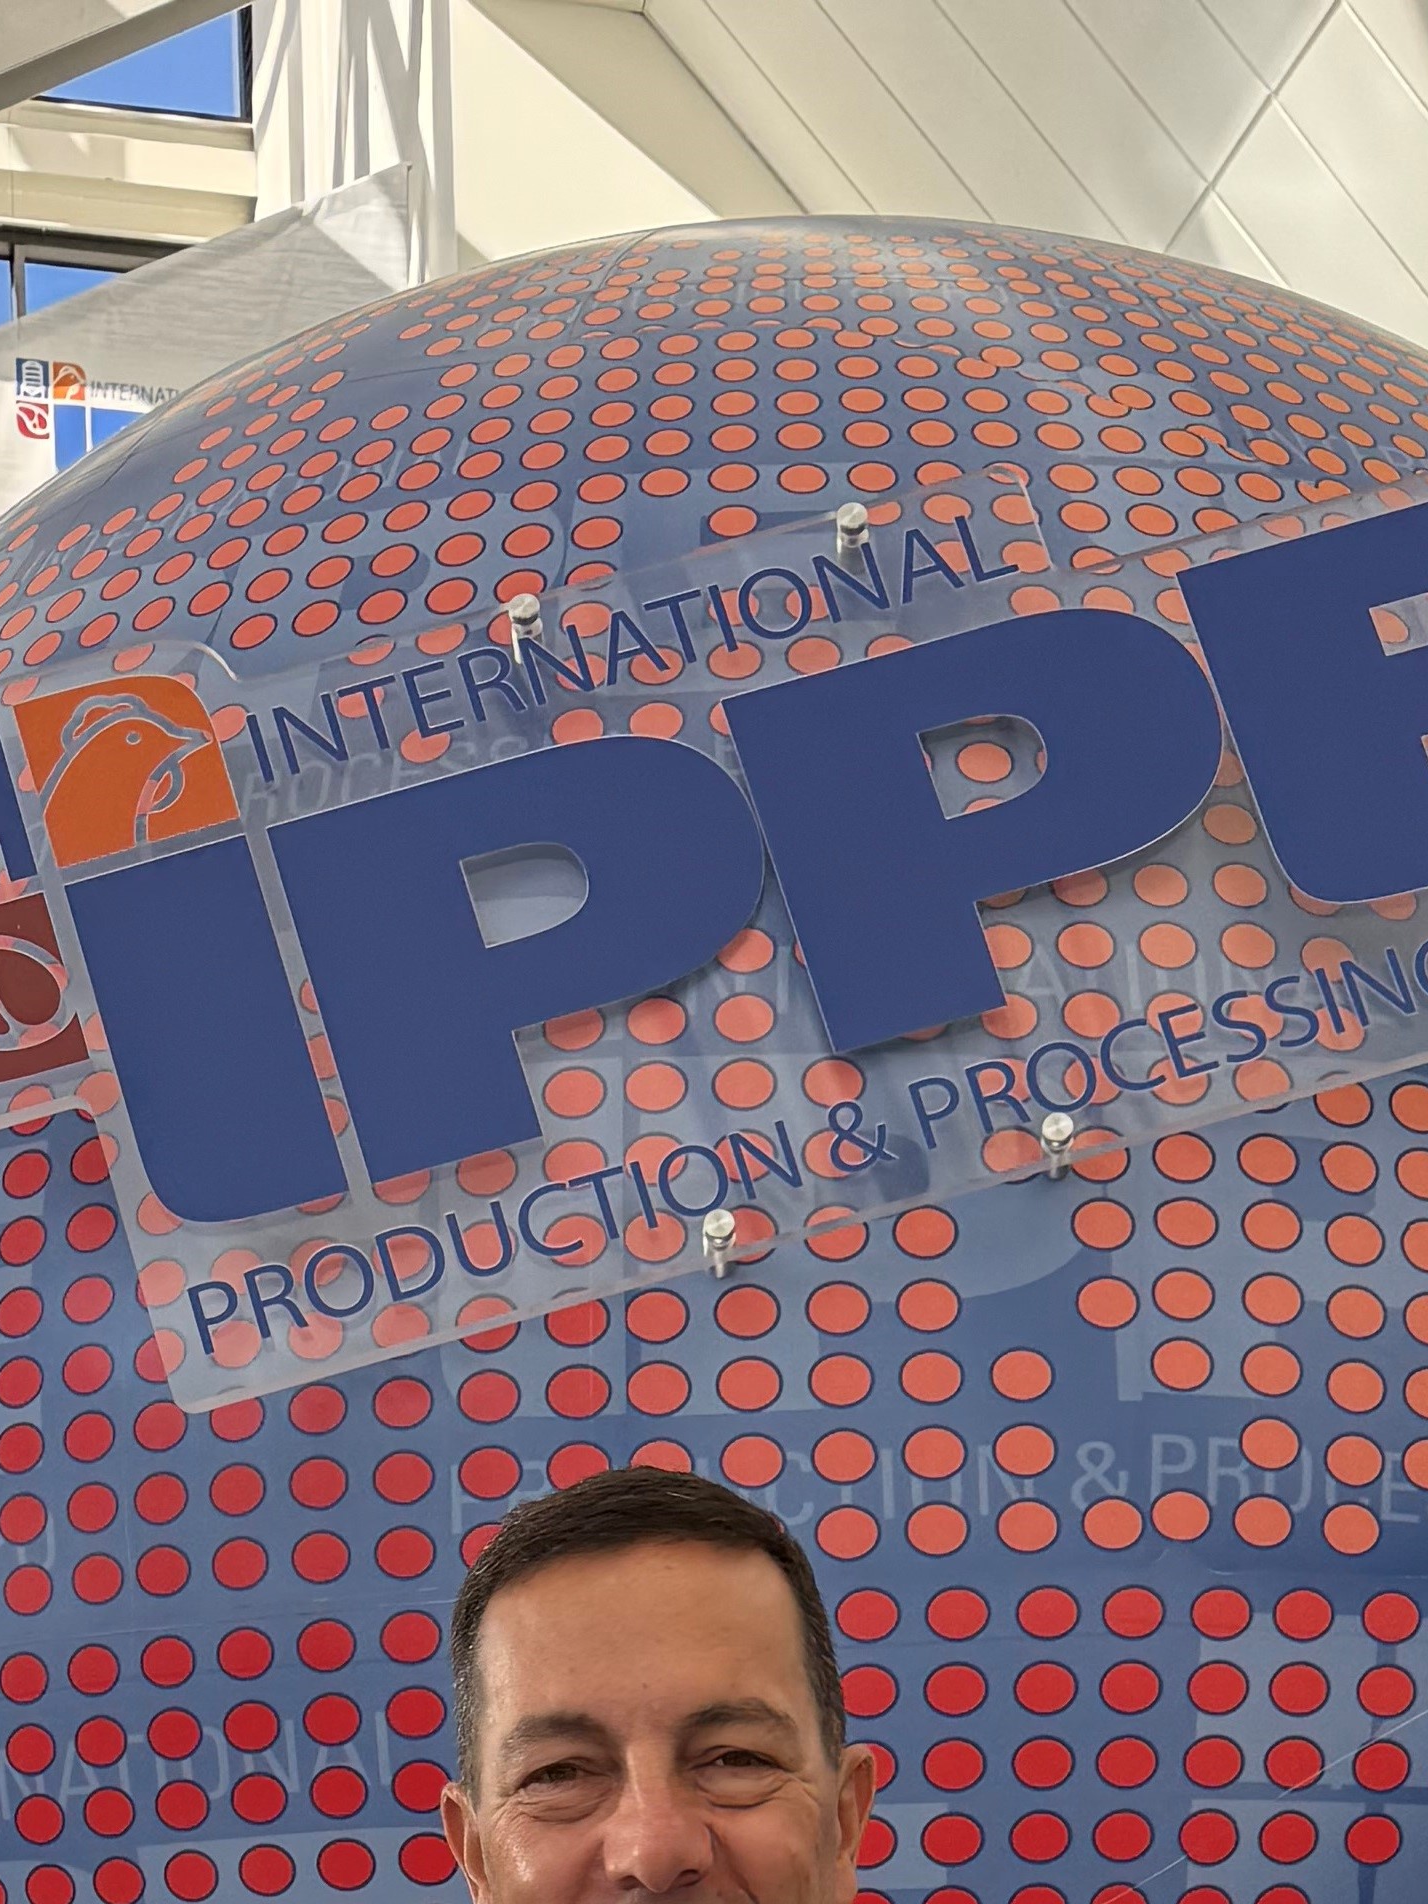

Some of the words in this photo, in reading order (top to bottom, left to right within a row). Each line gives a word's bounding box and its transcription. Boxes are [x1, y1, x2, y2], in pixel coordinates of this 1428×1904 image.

[91, 380, 179, 405] INTERNAT
[245, 515, 1018, 784] INTERNATIONAL
[188, 1118, 805, 1355] PRODUCTION
[828, 1099, 899, 1167] &
[1070, 1438, 1129, 1511] &
